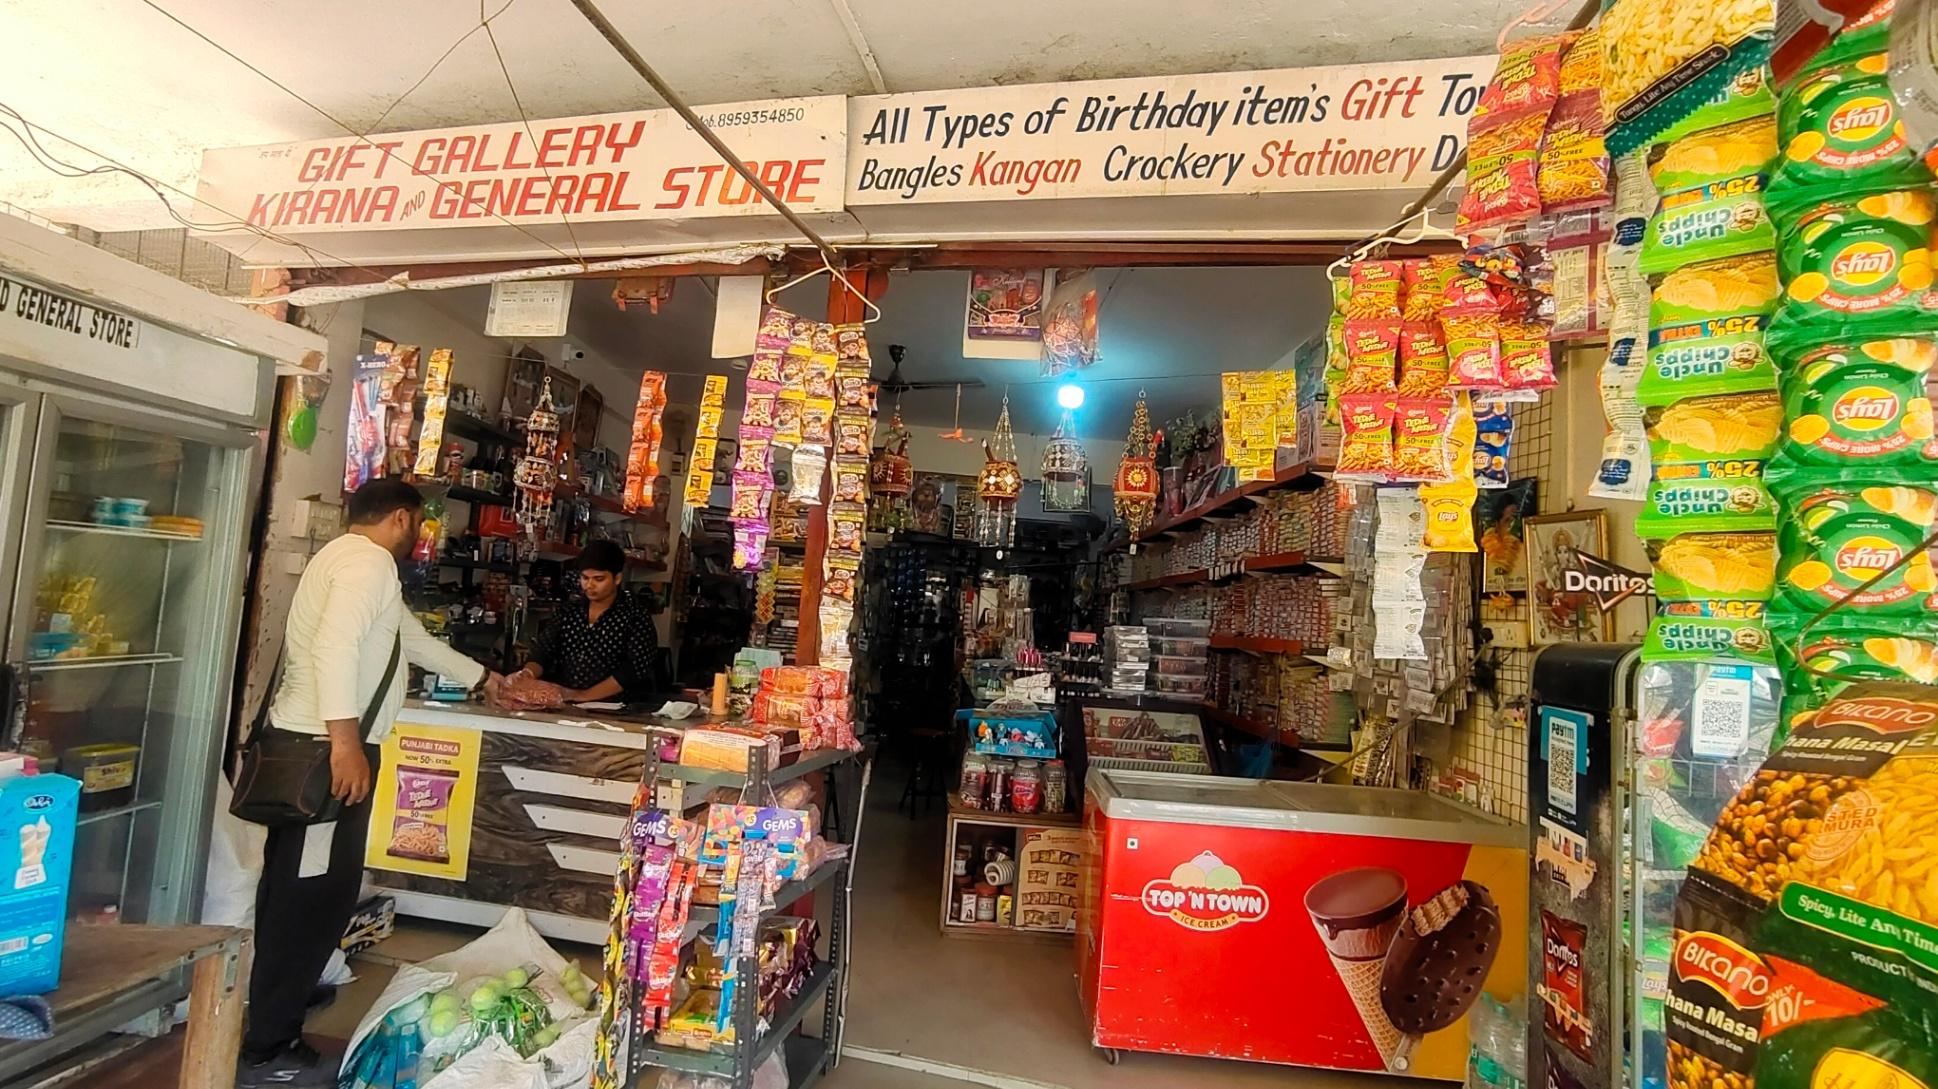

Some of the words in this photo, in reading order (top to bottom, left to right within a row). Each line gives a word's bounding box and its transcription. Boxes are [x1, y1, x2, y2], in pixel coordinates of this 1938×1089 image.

[864, 106, 910, 146] All
[922, 105, 1014, 149] Types
[1024, 97, 1069, 134] of
[1076, 90, 1228, 137] Birthday
[1232, 84, 1331, 126] item's
[1340, 76, 1424, 121] Gift
[298, 141, 403, 183] GIFT
[412, 121, 647, 176] GALLERY
[858, 156, 963, 199] Bangles
[968, 151, 1082, 196] Kangan
[1103, 142, 1246, 187] Crockery
[1252, 138, 1427, 183] Stationery
[247, 186, 400, 228] KIRANA
[400, 190, 427, 221] AND
[429, 171, 641, 220] GENERAL
[655, 159, 827, 210] STORE
[1708, 175, 1760, 200] 25%
[1657, 207, 1732, 234] Chipps
[1661, 223, 1725, 247] Uncle
[16, 287, 82, 334] GENERAL
[89, 310, 134, 348] STORE
[1707, 316, 1760, 337] 25%
[1656, 347, 1730, 366] Chipps
[1660, 361, 1723, 379] Uncle
[1707, 460, 1760, 479] 25%
[1655, 488, 1729, 504] Chipps
[1659, 503, 1723, 515] Uncle
[1565, 570, 1657, 594] Doritos
[1709, 601, 1763, 619] 25%
[1658, 625, 1732, 641] Chipps
[1663, 638, 1728, 651] Uncle
[401, 739, 433, 750] PUNJABI
[434, 743, 459, 753] TADKA
[1786, 735, 1833, 748] hana
[1832, 737, 1909, 755] Masal
[762, 818, 797, 832] GEMS
[1827, 807, 1878, 823] STED
[633, 820, 667, 838] GEMS
[1823, 818, 1876, 833] MURA
[1149, 889, 1185, 908] TOP
[1188, 890, 1204, 910] 'N
[1206, 895, 1262, 914] TOWN
[1798, 895, 1836, 918] Spicy,
[1839, 907, 1867, 928] Lite
[1180, 916, 1195, 927] ICE
[1198, 917, 1229, 929] CREAM
[1851, 951, 1907, 977] PRODUCT
[1665, 989, 1704, 1020] hana
[1705, 1007, 1760, 1044] Masa
